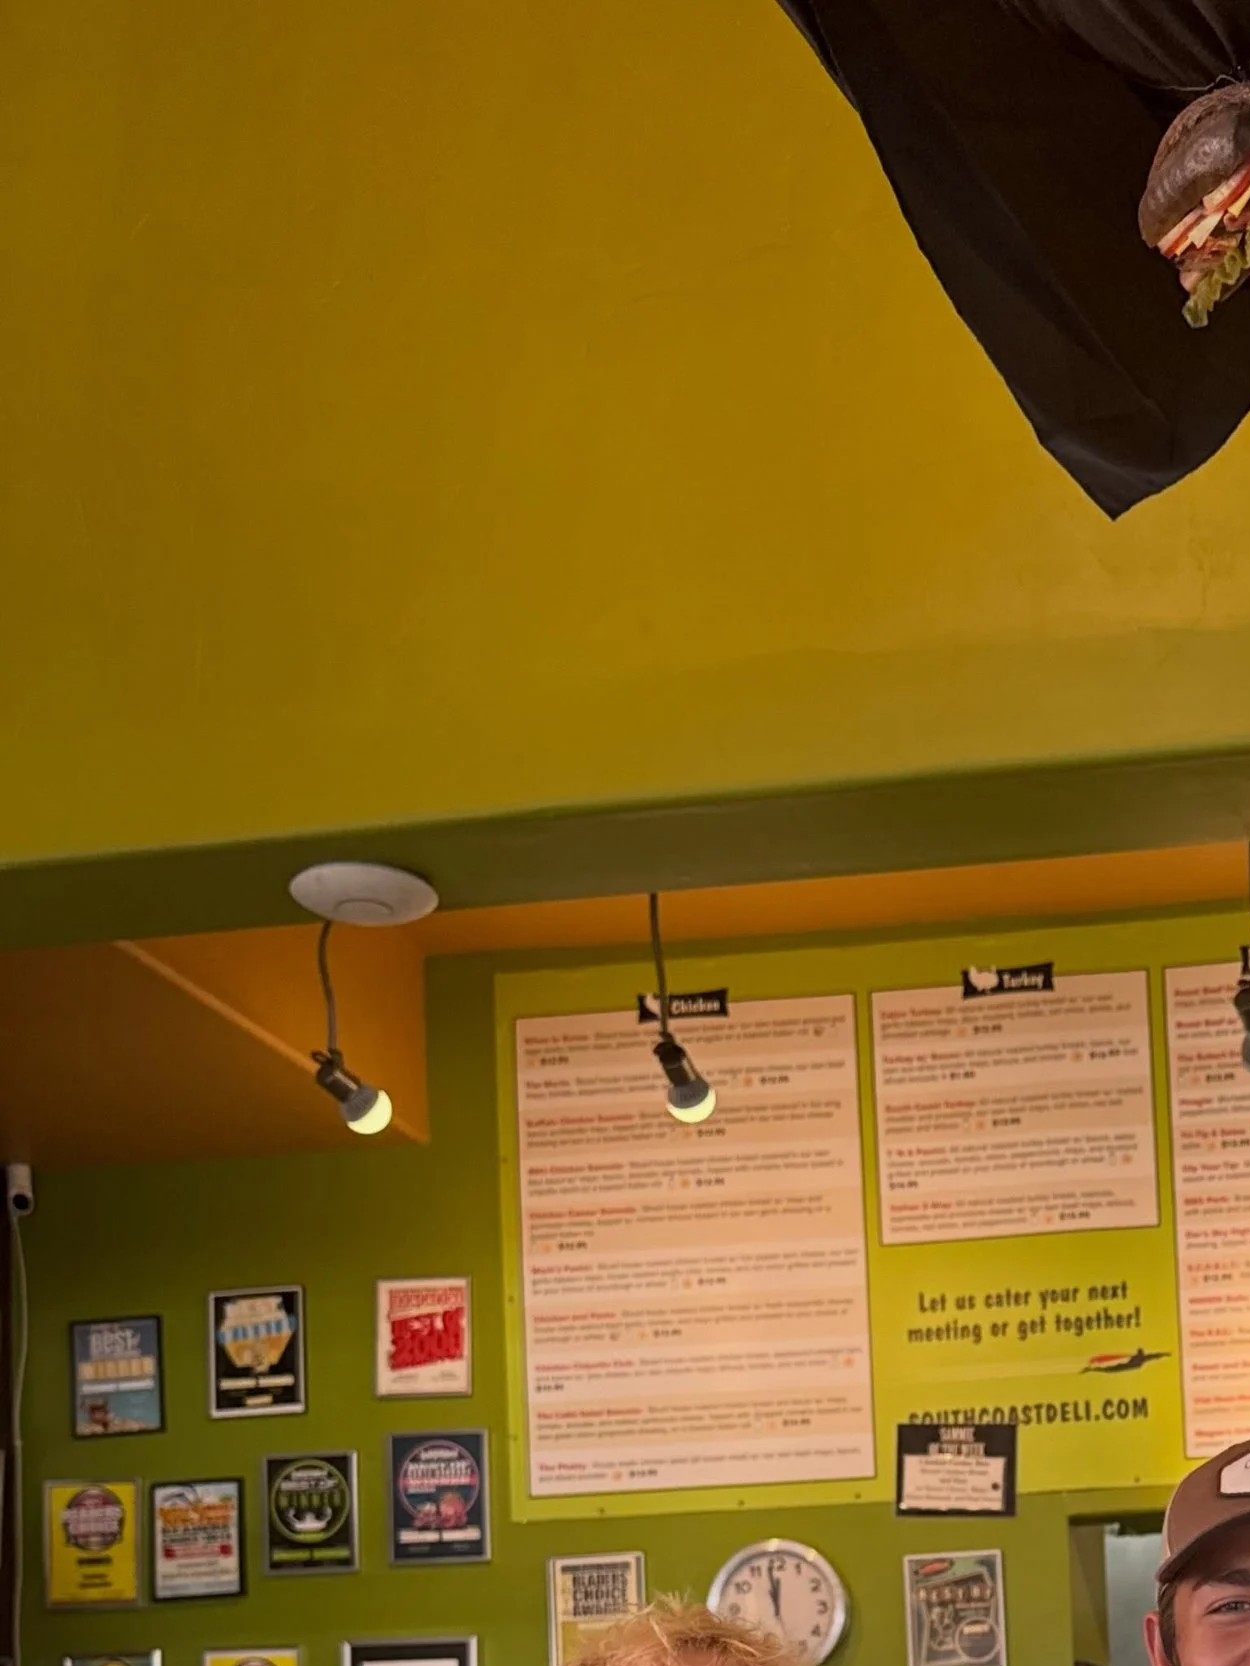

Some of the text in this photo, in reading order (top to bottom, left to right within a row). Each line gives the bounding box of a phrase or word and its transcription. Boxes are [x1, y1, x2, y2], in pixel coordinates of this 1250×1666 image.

[1002, 972, 1044, 989] Turkey
[670, 998, 721, 1015] Chicken
[918, 1280, 1129, 1313] Let us cater your next
[907, 1305, 1142, 1344] meeting or get together!
[909, 1398, 1149, 1428] SOUTHCOASTDELI.COM
[734, 1579, 752, 1595] 10
[810, 1578, 820, 1592] 2
[817, 1599, 827, 1614] 3
[811, 1624, 821, 1638] 4
